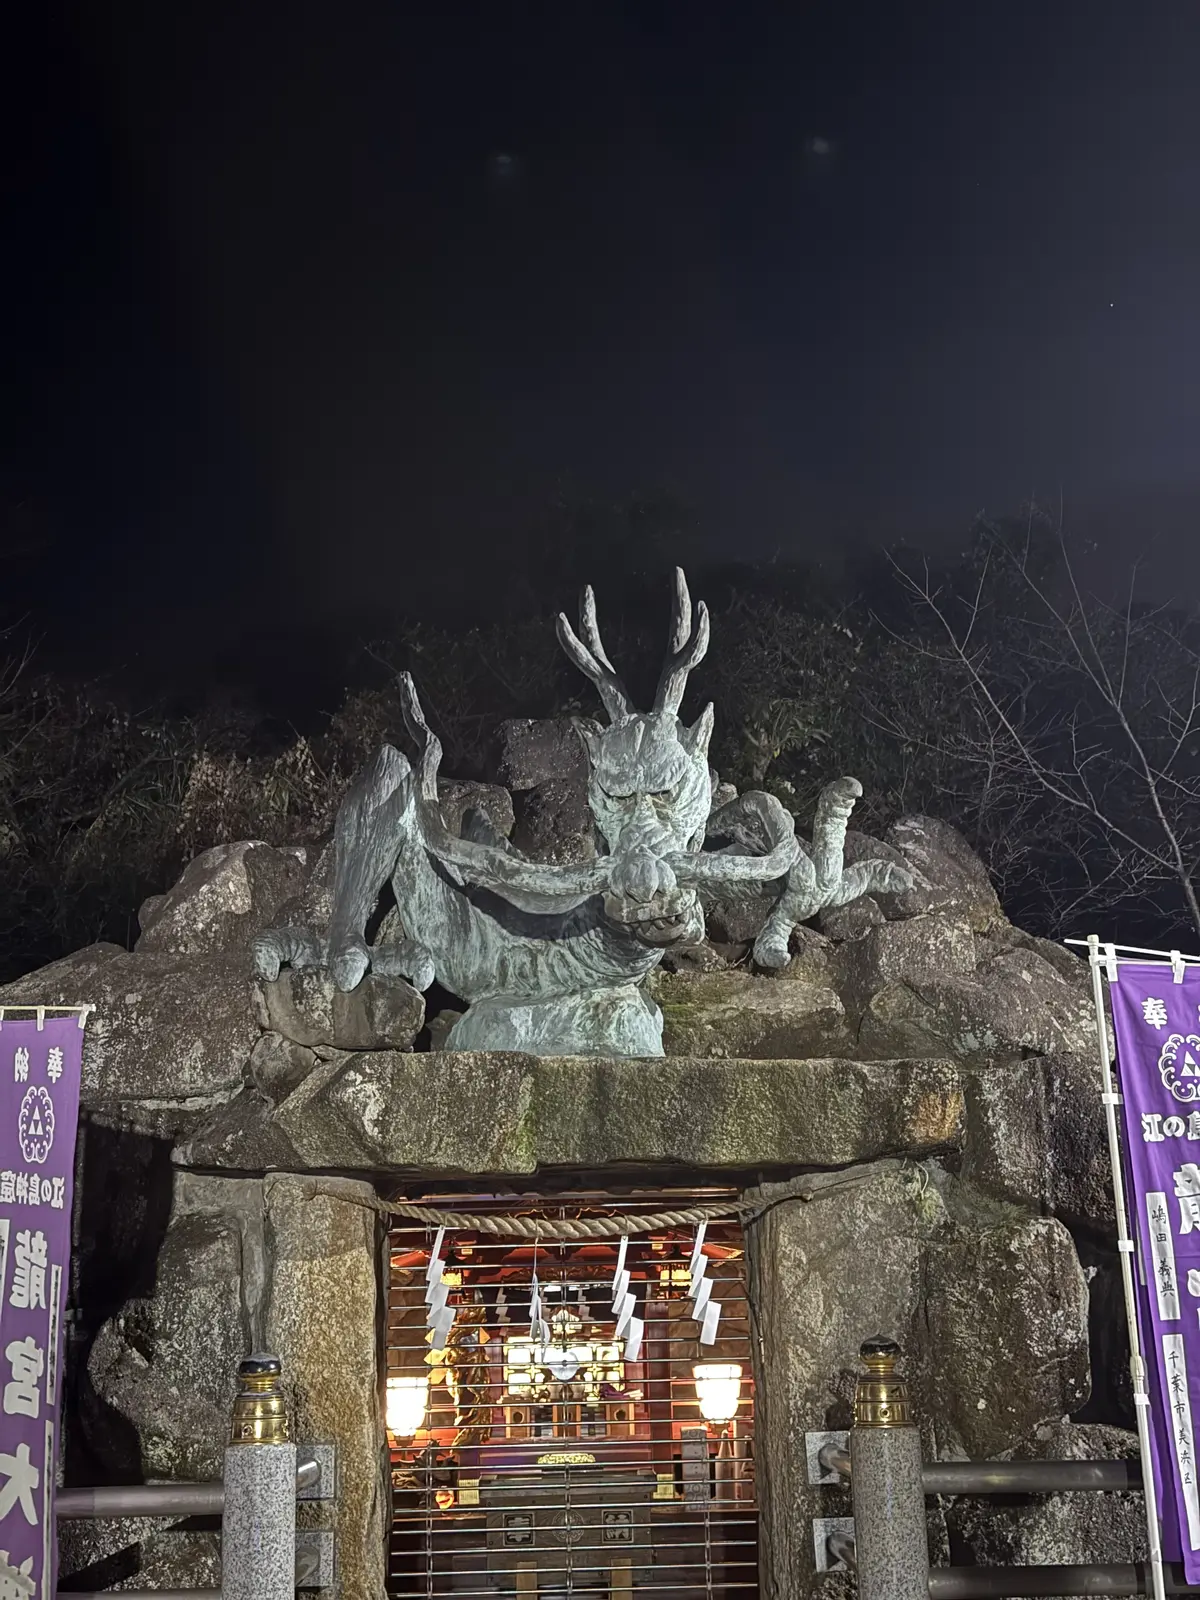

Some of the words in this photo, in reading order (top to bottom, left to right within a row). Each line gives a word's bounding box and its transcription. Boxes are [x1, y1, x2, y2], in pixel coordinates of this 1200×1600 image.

[1141, 997, 1168, 1030] 奉
[1167, 1350, 1193, 1485] 千葉市美浜区
